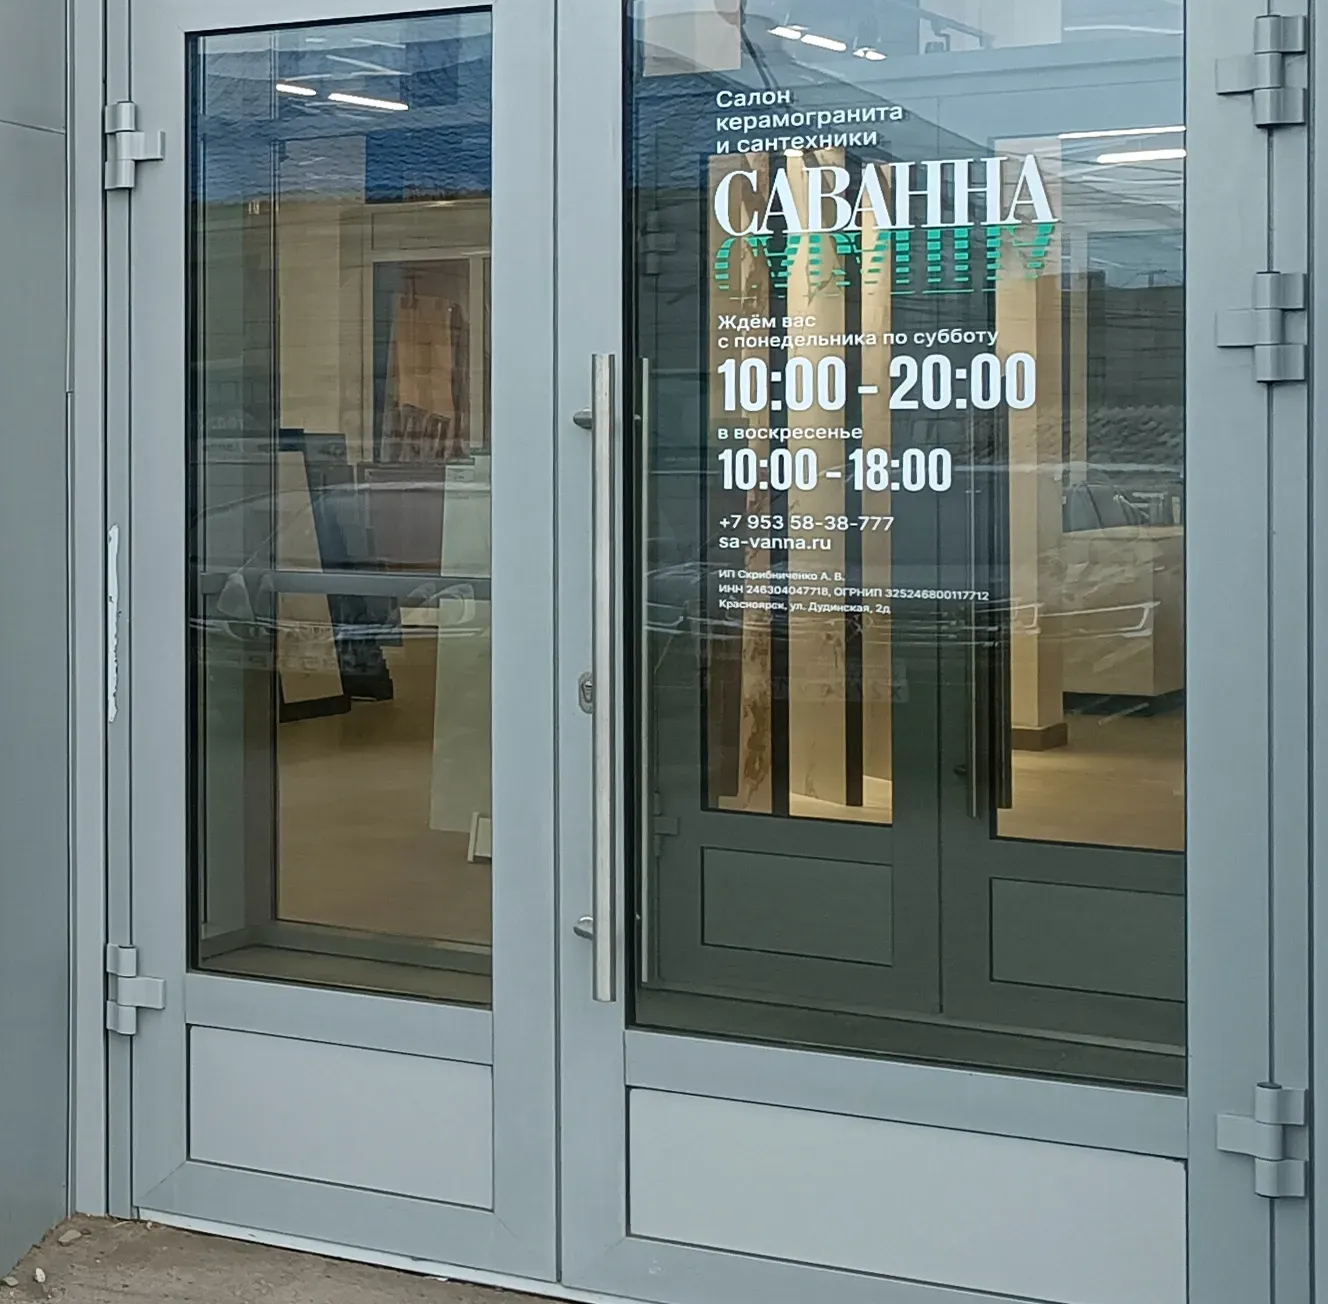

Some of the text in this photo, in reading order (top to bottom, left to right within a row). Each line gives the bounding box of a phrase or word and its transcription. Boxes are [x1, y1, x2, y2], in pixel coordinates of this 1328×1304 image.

[716, 89, 790, 108] Салон
[716, 106, 903, 133] керамогранита
[716, 130, 877, 154] и сантехники
[714, 154, 1059, 236] САВАННА
[717, 313, 816, 331] Ждём вас
[717, 328, 999, 349] с понедельника по субботу
[717, 356, 847, 412] 10:00
[889, 352, 1037, 411] 20:00
[717, 426, 863, 443] в воскресенье
[717, 448, 818, 492] 10:00
[848, 448, 952, 492] 18:00
[719, 515, 894, 532] +7 953 58-38-777
[719, 534, 831, 551] sa-vanna.ru
[718, 569, 845, 582] ИП Скрибниченко А. В.
[718, 584, 744, 595] ИНН
[746, 585, 832, 598] 246304047718,
[834, 587, 883, 598] ОГРНИП
[718, 599, 891, 615] Красноярск, ул. Дудинская, 2д
